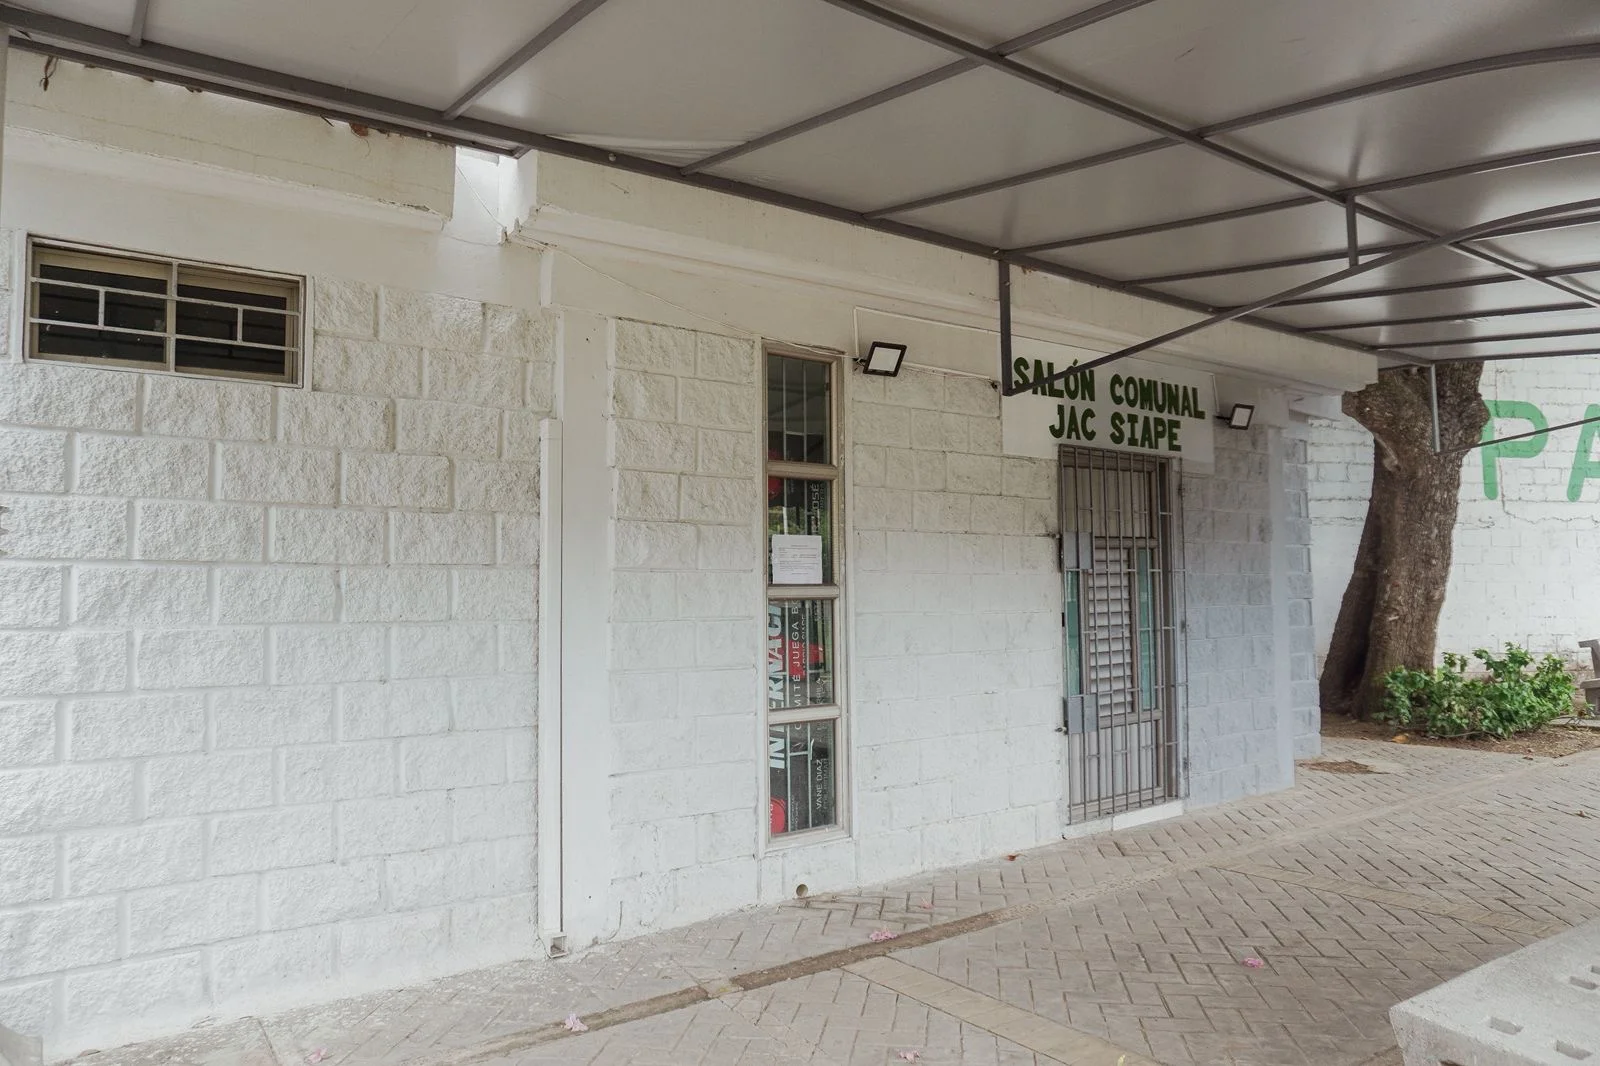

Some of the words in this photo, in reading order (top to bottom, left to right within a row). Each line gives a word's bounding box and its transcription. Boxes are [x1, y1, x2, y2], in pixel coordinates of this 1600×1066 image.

[1013, 357, 1095, 402] SALÓN
[1109, 373, 1206, 420] COMUNAL
[1048, 404, 1097, 441] JAC
[1109, 411, 1182, 452] SIAPE
[1481, 399, 1600, 503] PA
[791, 620, 801, 668] JUEGA
[791, 674, 802, 731] CMITÉ
